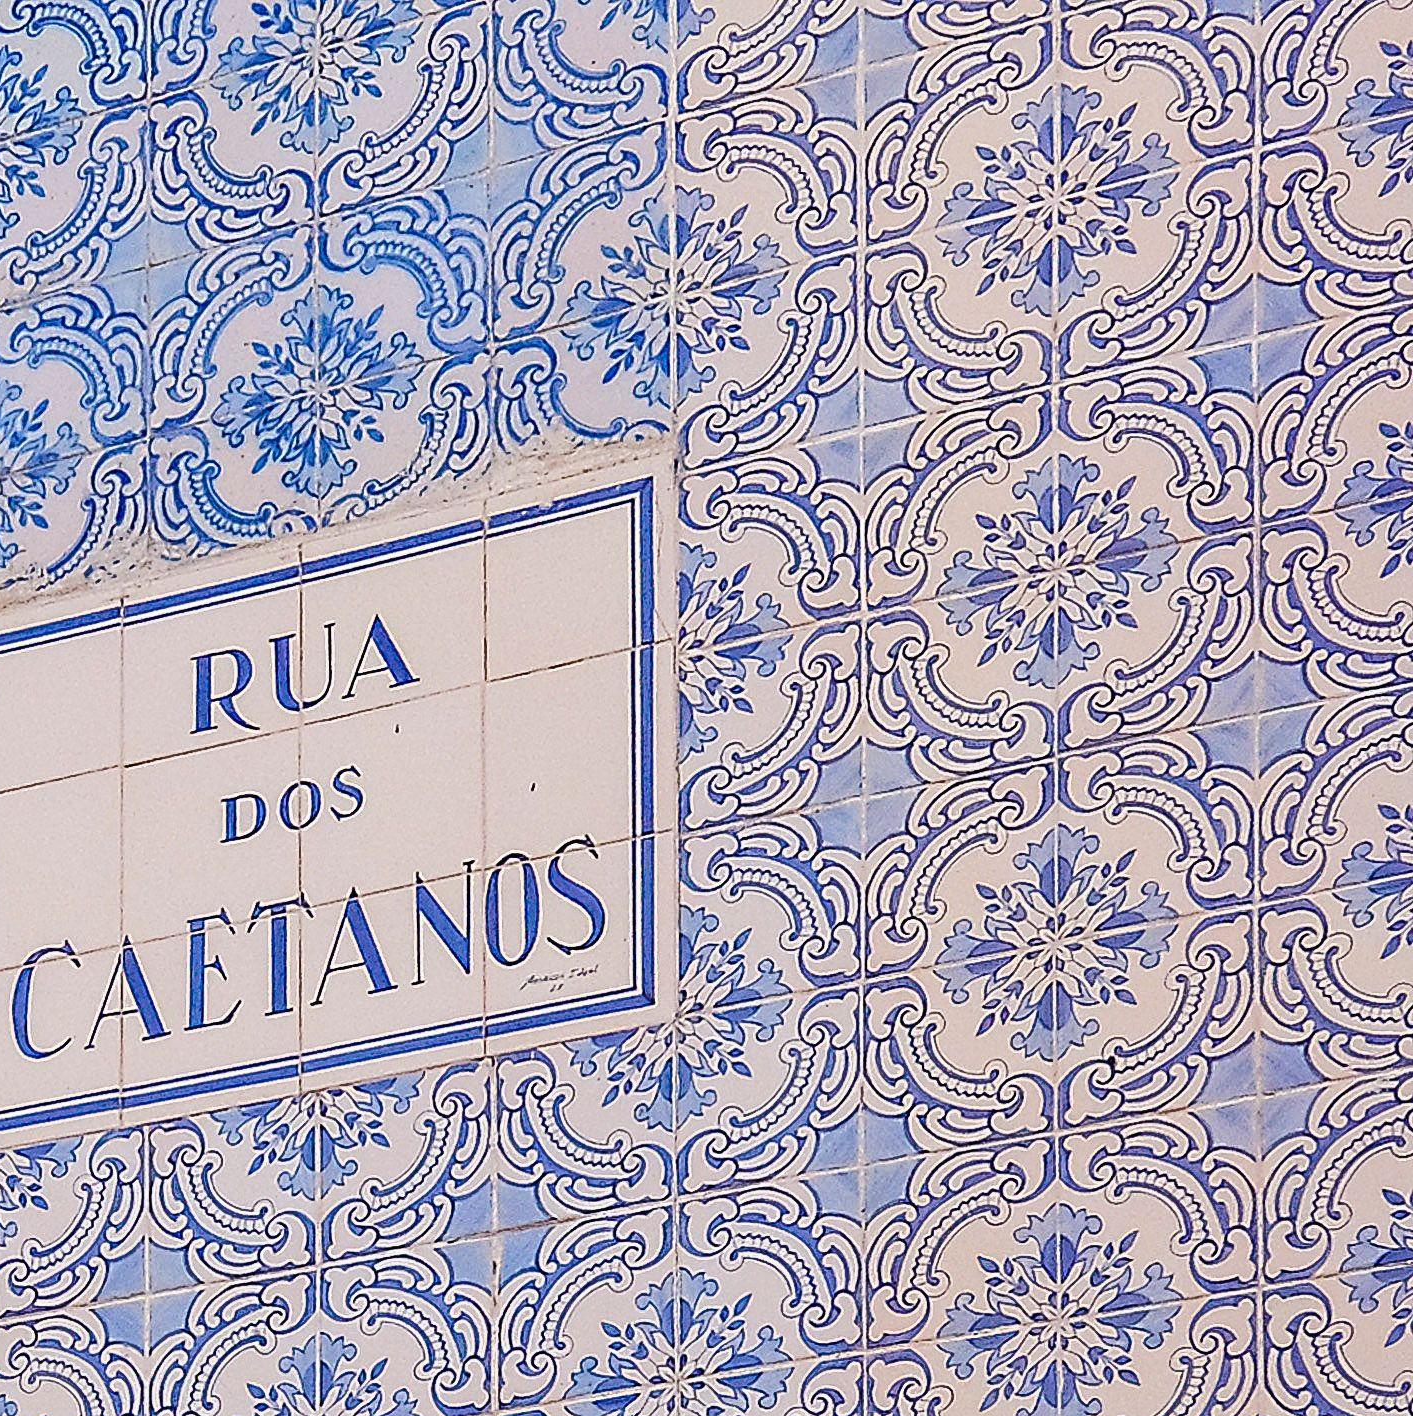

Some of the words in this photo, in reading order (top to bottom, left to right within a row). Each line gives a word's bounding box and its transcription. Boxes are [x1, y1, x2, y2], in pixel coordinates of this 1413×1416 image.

[189, 614, 420, 734] RUA
[220, 765, 365, 843] DOS
[11, 835, 607, 1060] CAETANOS
